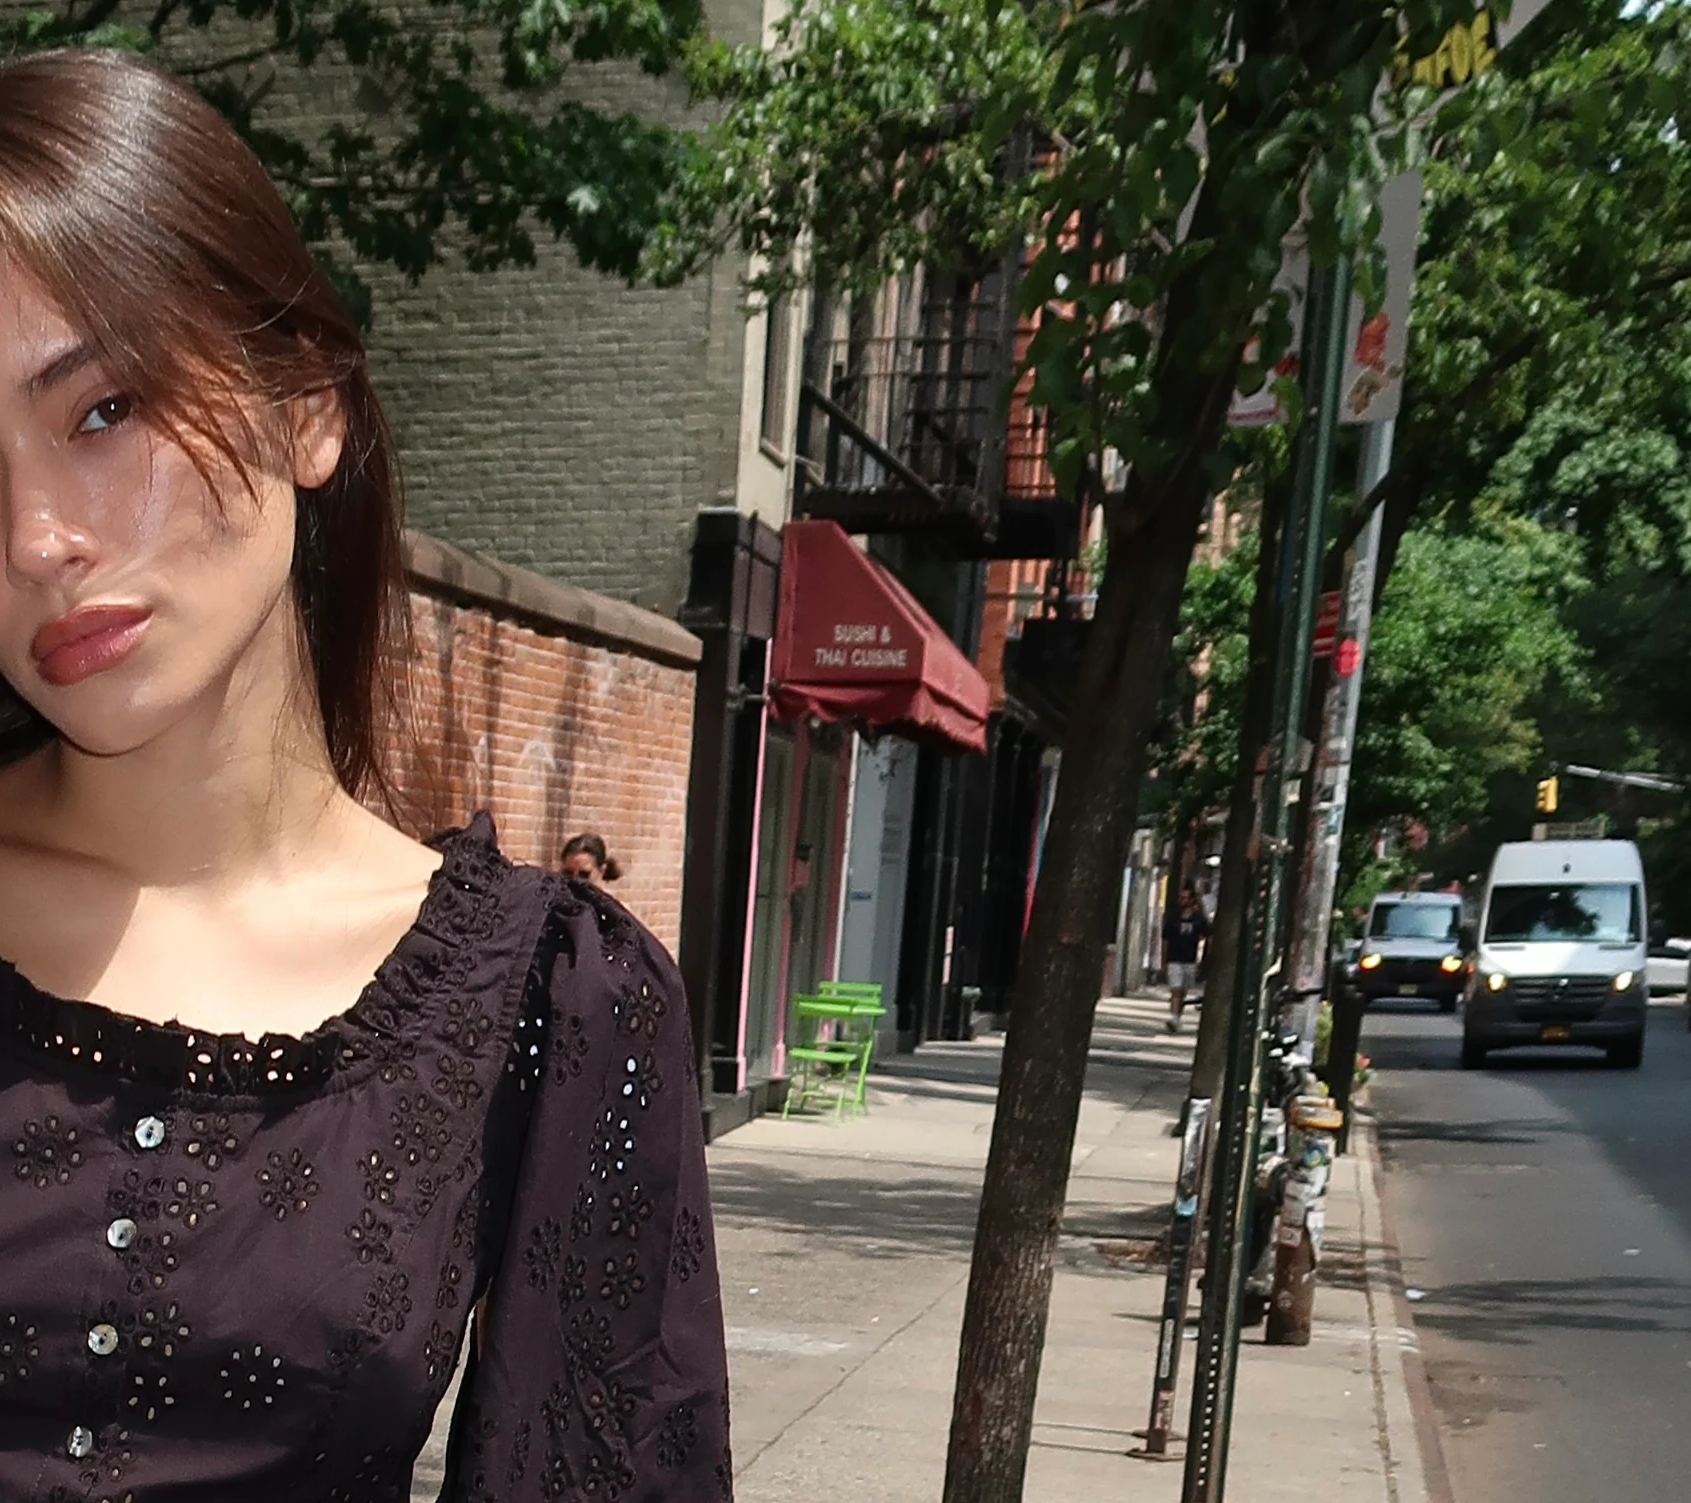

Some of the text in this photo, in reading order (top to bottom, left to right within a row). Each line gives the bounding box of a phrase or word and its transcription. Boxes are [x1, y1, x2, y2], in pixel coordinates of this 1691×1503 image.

[834, 624, 877, 643] SUSHI
[815, 647, 907, 668] THAI CUISINE
